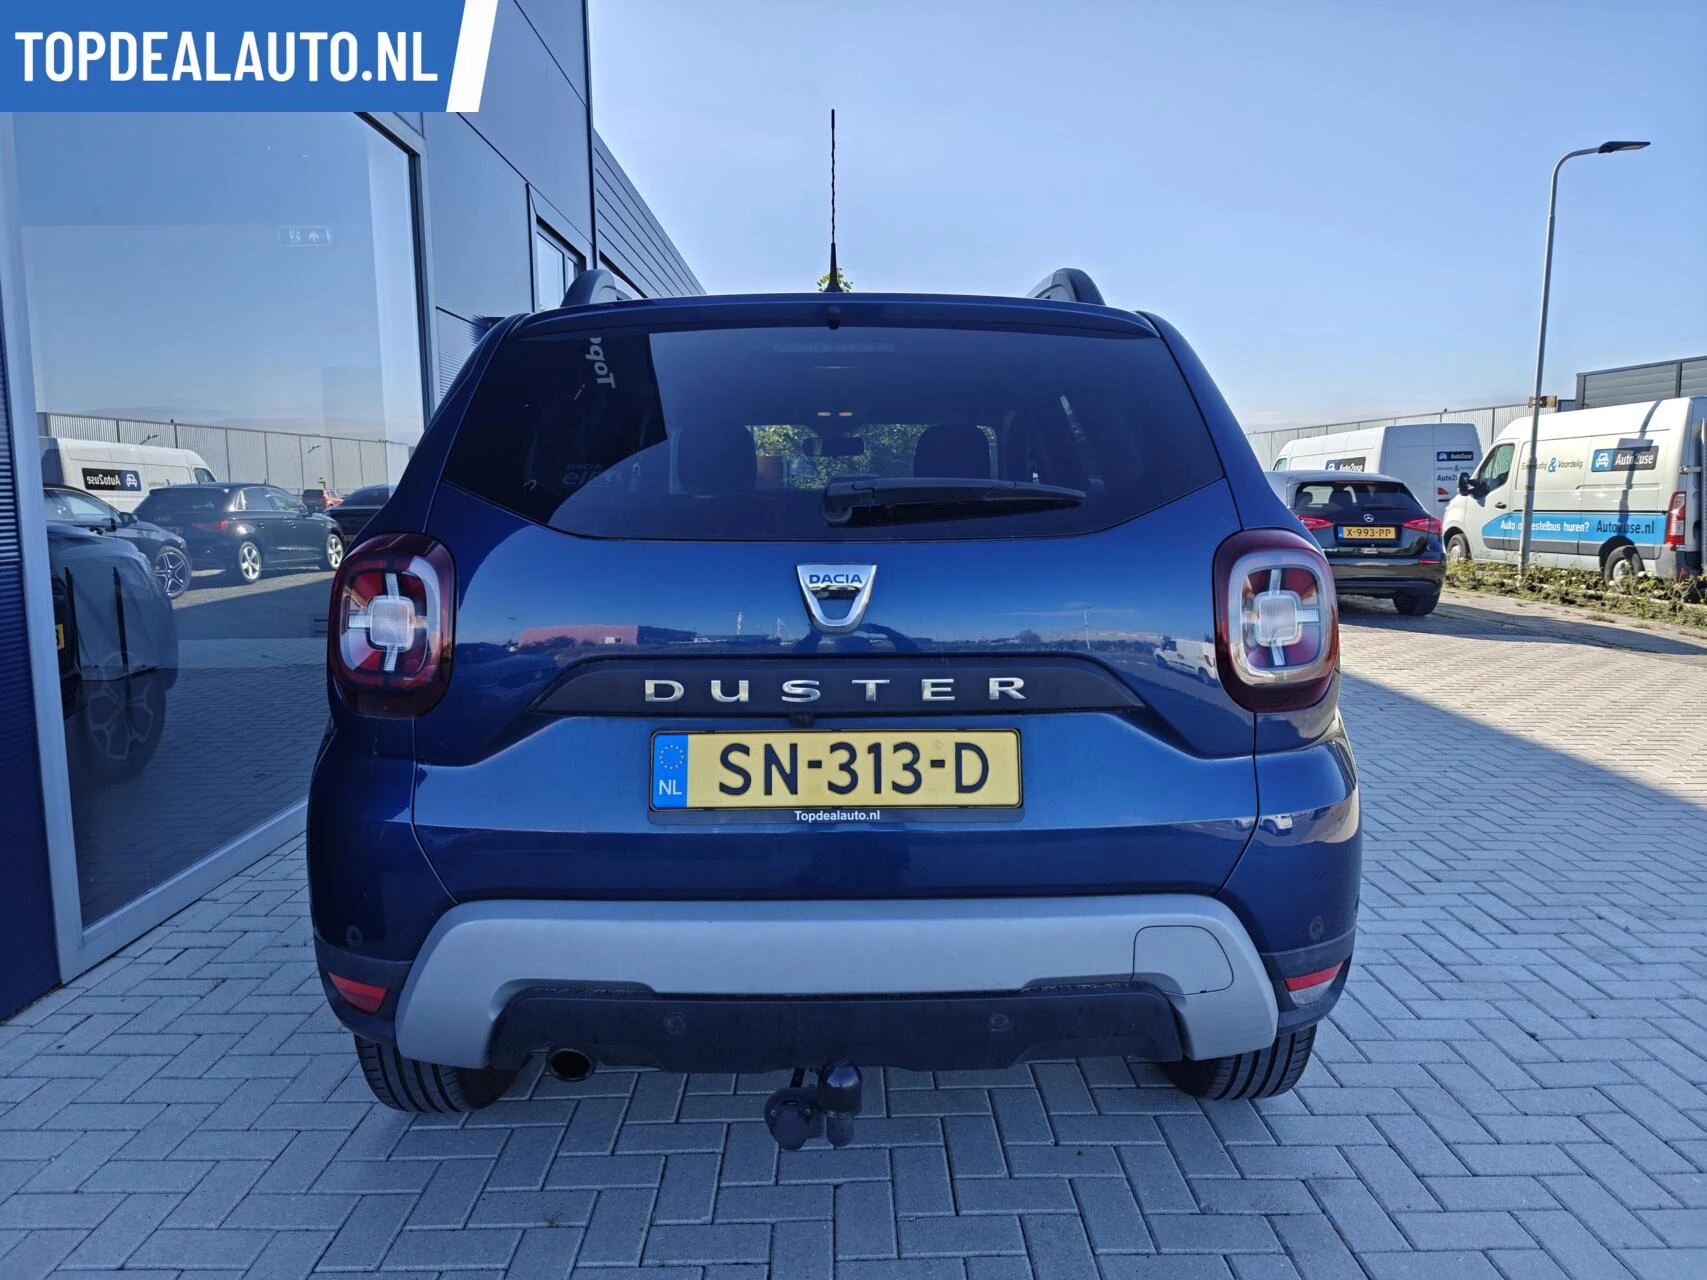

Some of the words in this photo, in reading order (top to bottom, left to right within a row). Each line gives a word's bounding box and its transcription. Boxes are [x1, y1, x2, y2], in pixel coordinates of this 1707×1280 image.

[1547, 457, 1557, 473] &
[1558, 459, 1583, 470] Voordelig
[1346, 528, 1391, 537] X-993-PP
[1500, 520, 1515, 530] Auto
[1530, 521, 1561, 532] estelbus
[1563, 521, 1590, 533] huren?
[1596, 520, 1655, 535] Auto2use.nl
[808, 573, 863, 585] DACIA
[644, 677, 1026, 702] DUSTER
[719, 742, 990, 796] SN-313-D
[658, 779, 682, 796] NL
[794, 810, 881, 823] Topdealauto.nl
